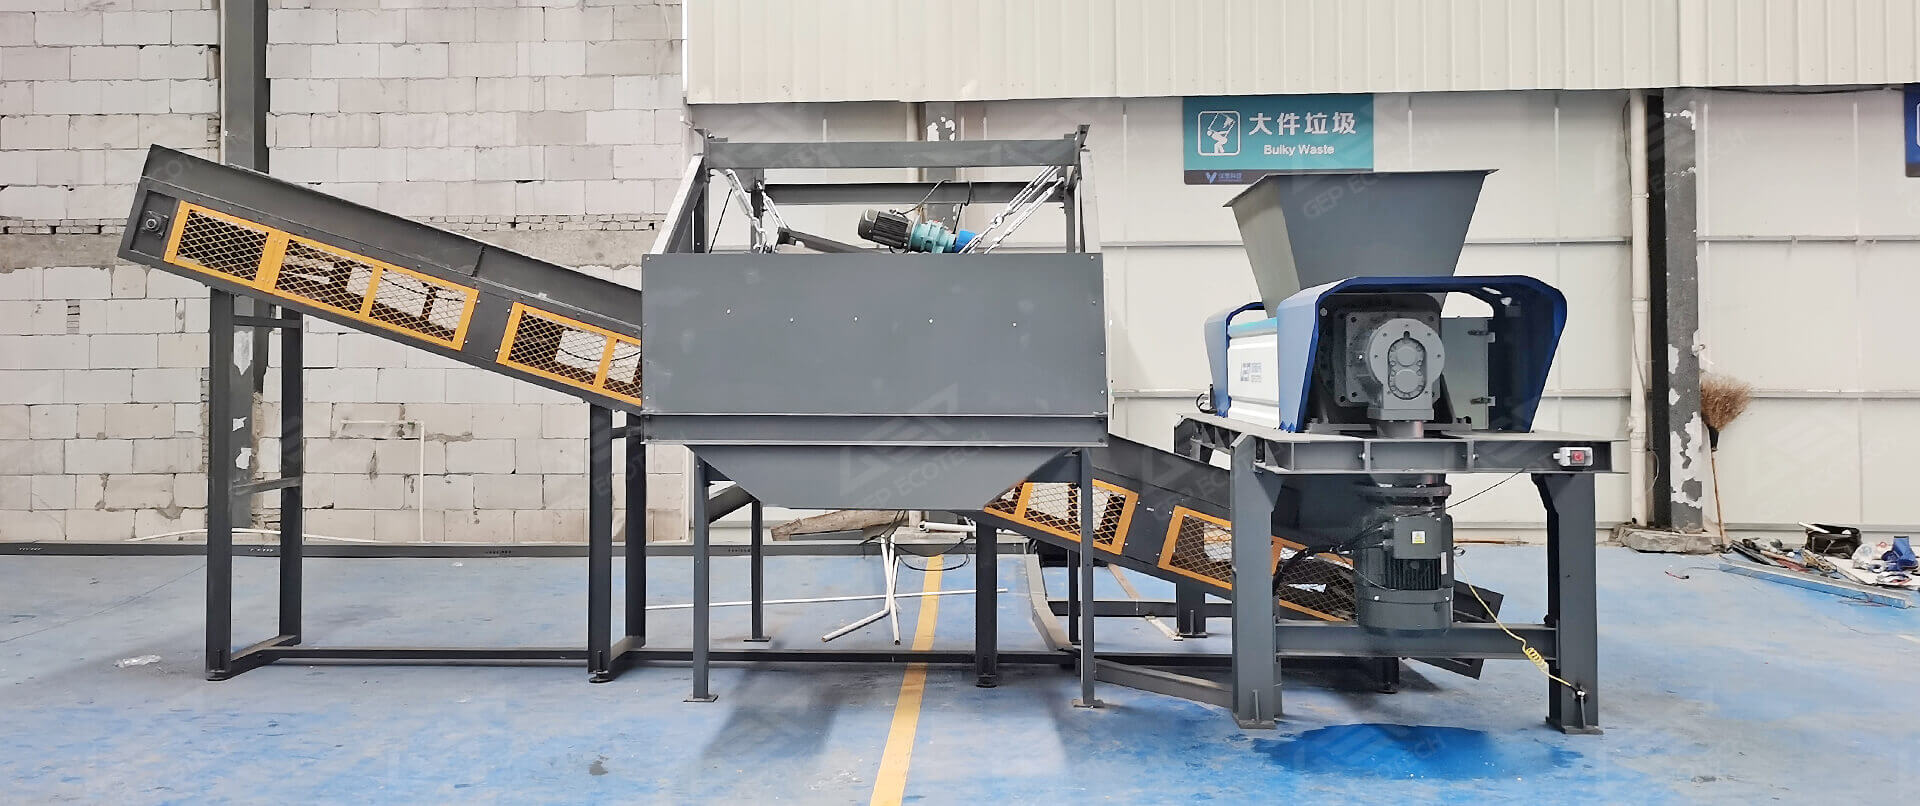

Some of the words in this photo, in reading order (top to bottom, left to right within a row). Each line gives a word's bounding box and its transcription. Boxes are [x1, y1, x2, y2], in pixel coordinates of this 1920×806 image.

[1249, 112, 1357, 136] 大件垃圾
[1264, 144, 1295, 156] Bulky
[1299, 144, 1335, 155] Waste
